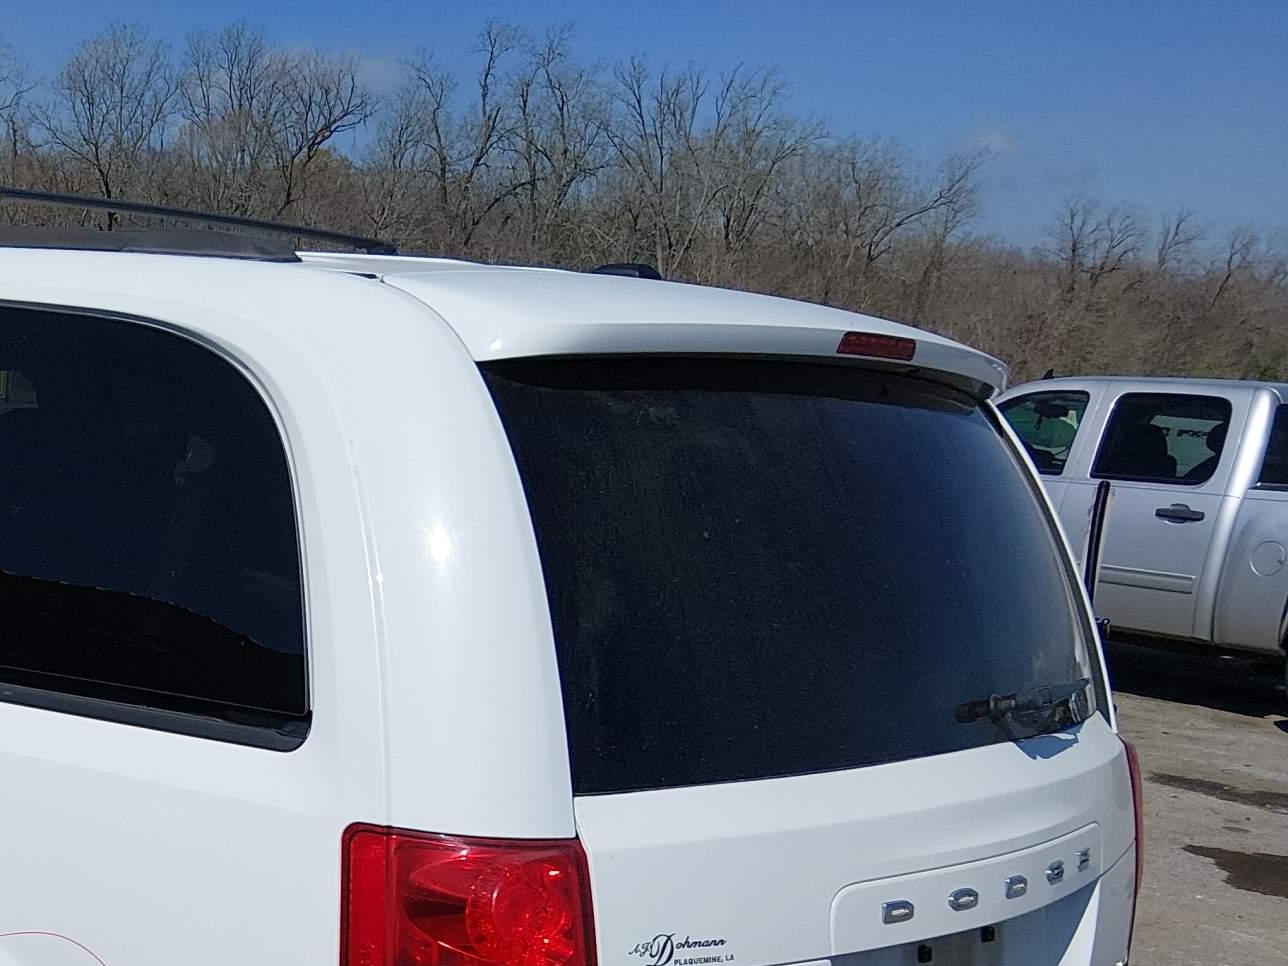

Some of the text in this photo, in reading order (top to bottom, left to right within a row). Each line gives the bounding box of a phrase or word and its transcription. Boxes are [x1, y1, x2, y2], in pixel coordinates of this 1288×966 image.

[881, 848, 1091, 925] DODGE
[673, 954, 734, 966] PLAQUEMINE, LA
